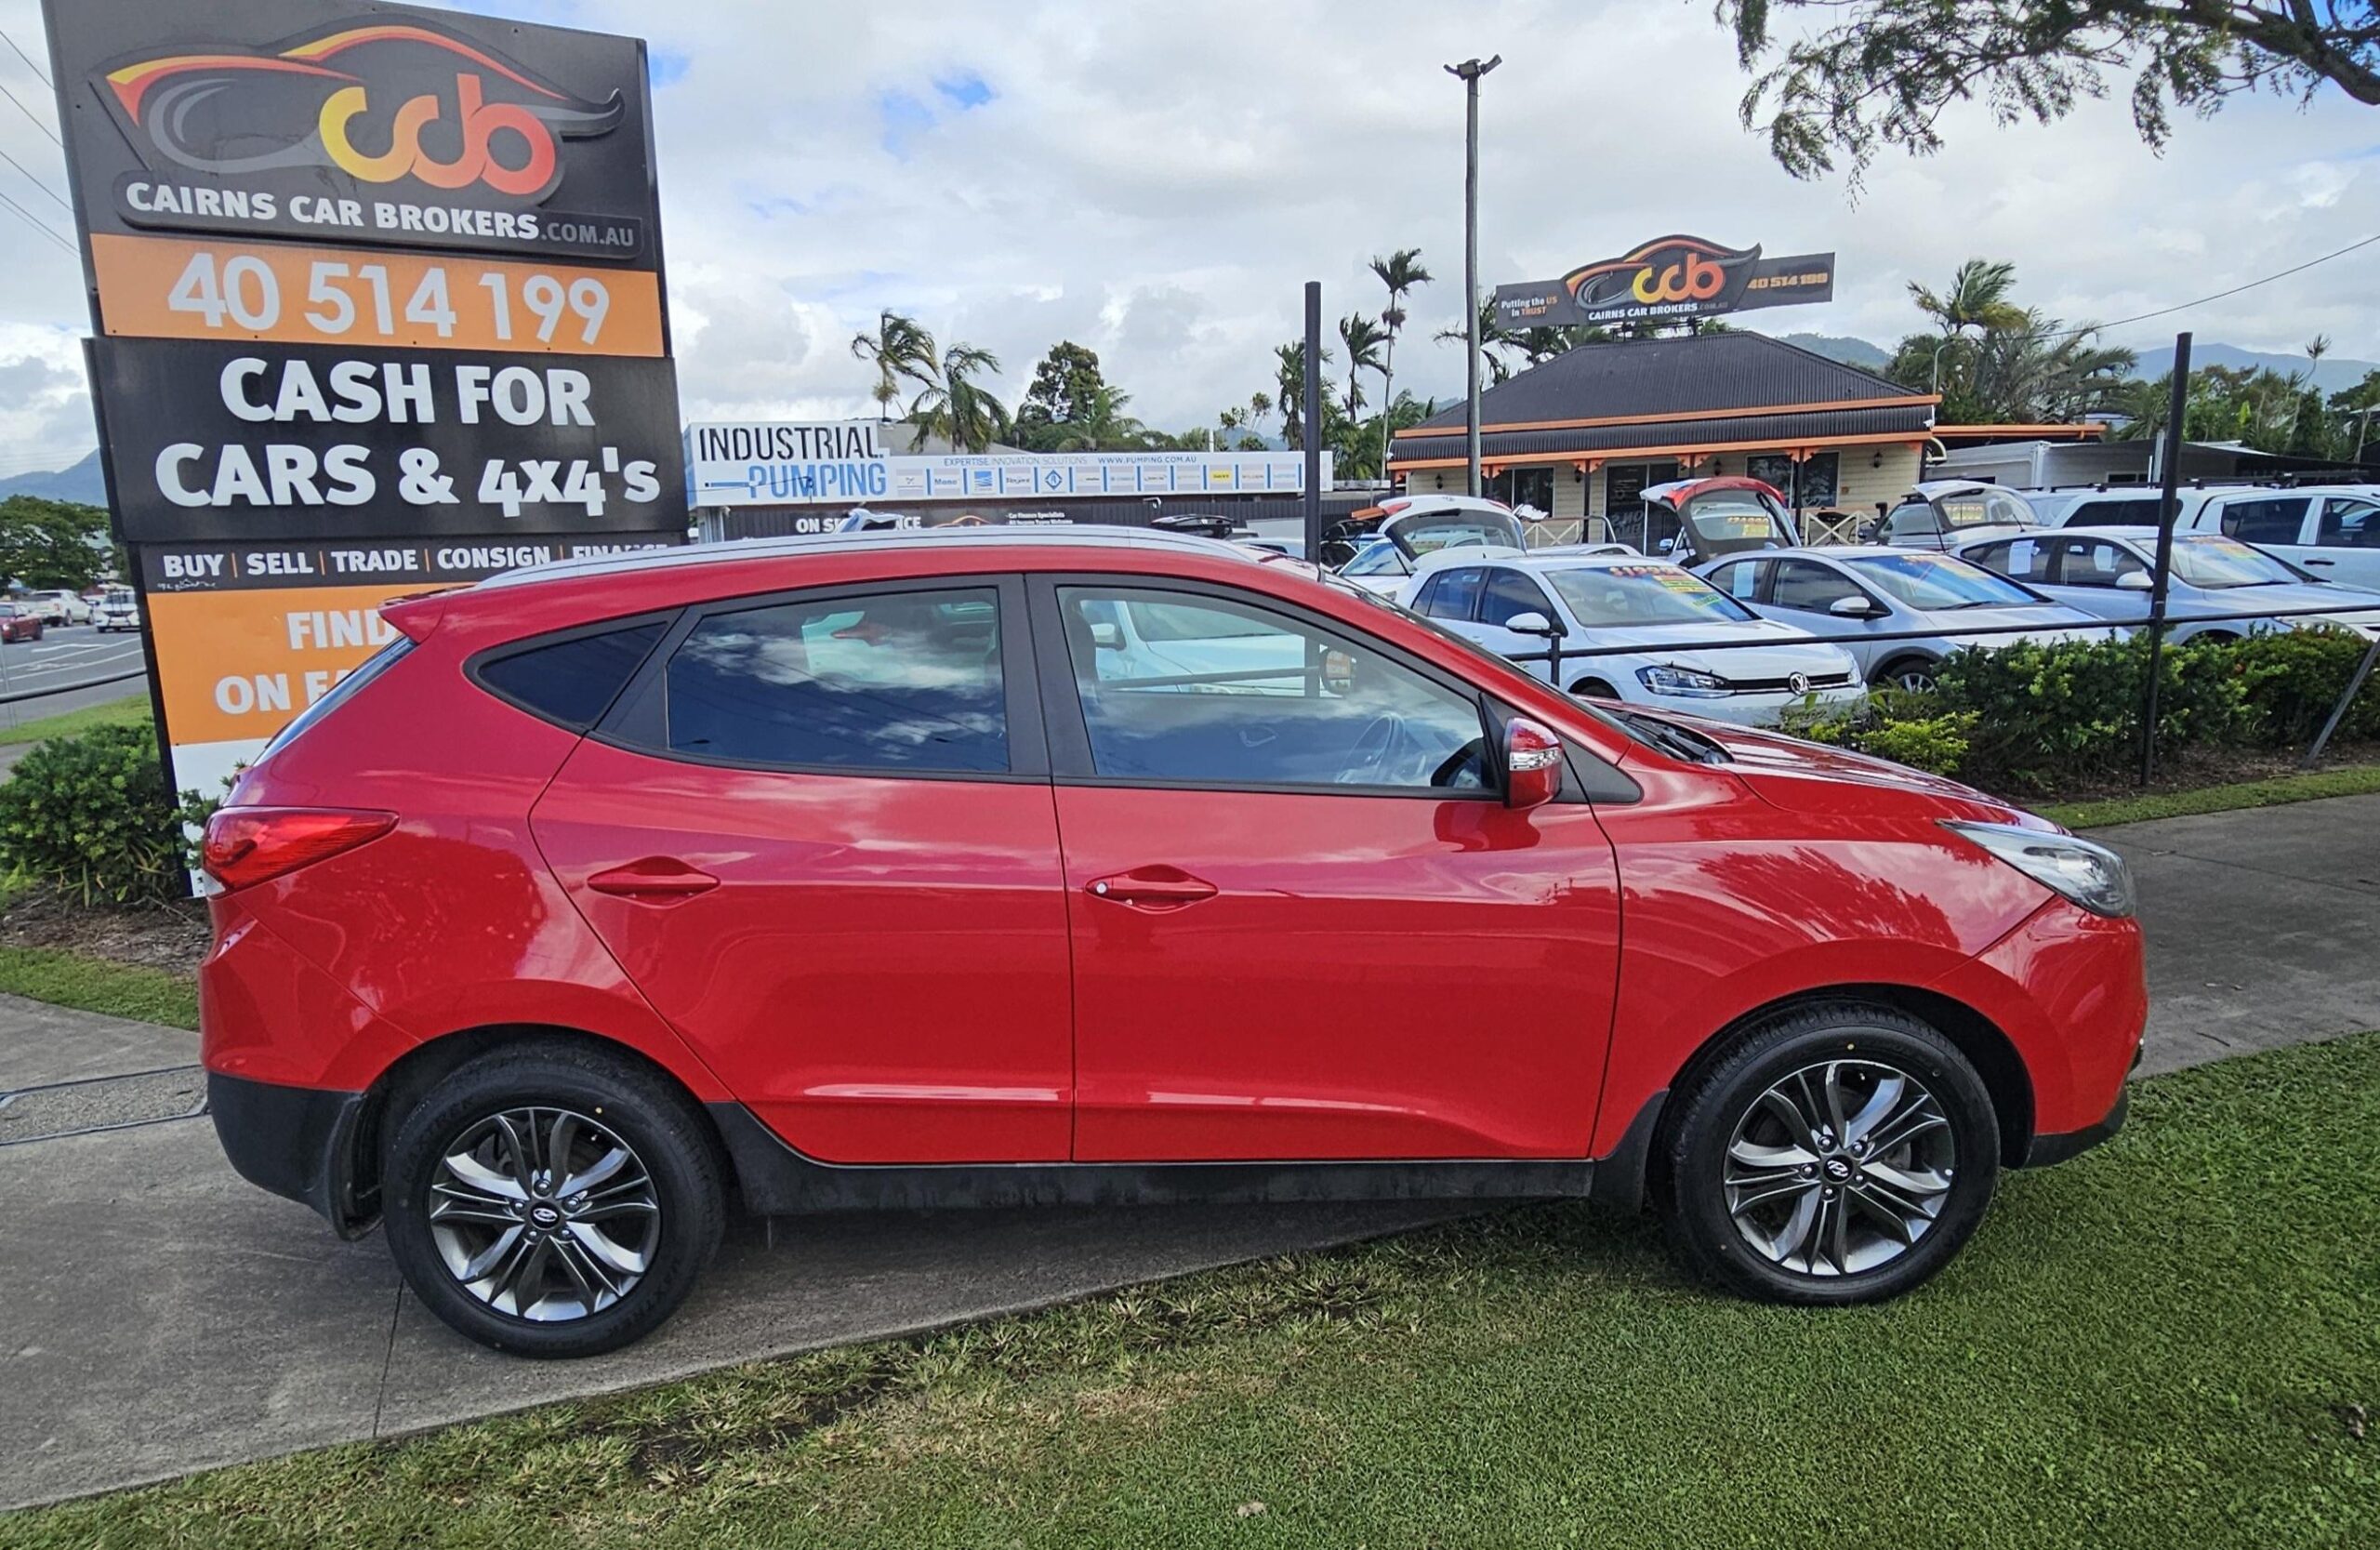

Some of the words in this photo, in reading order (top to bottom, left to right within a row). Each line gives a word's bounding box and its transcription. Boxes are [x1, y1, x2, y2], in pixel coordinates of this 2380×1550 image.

[126, 182, 277, 220] CAIRNS
[290, 195, 364, 228] CAR
[167, 252, 281, 331] 40
[304, 260, 457, 338] 514
[478, 272, 610, 345] 199
[1501, 298, 1530, 310] Putting
[1531, 297, 1545, 307] the
[1521, 306, 1547, 316] TRUST
[1588, 309, 1625, 321] CAIRNS
[1627, 306, 1647, 317] CAR
[220, 357, 435, 424] CASH
[456, 365, 596, 426] FOR
[699, 426, 882, 461] INDUSTRIAL
[155, 443, 376, 507] CARS
[399, 447, 460, 505] &
[747, 462, 887, 499] PUMPING
[795, 518, 821, 534] ON
[163, 554, 224, 577] BUY
[246, 552, 314, 576] SELL
[330, 549, 418, 573] TRADE
[437, 546, 551, 570] CONSIGN
[286, 609, 398, 650] FIND
[215, 673, 292, 715] ON
